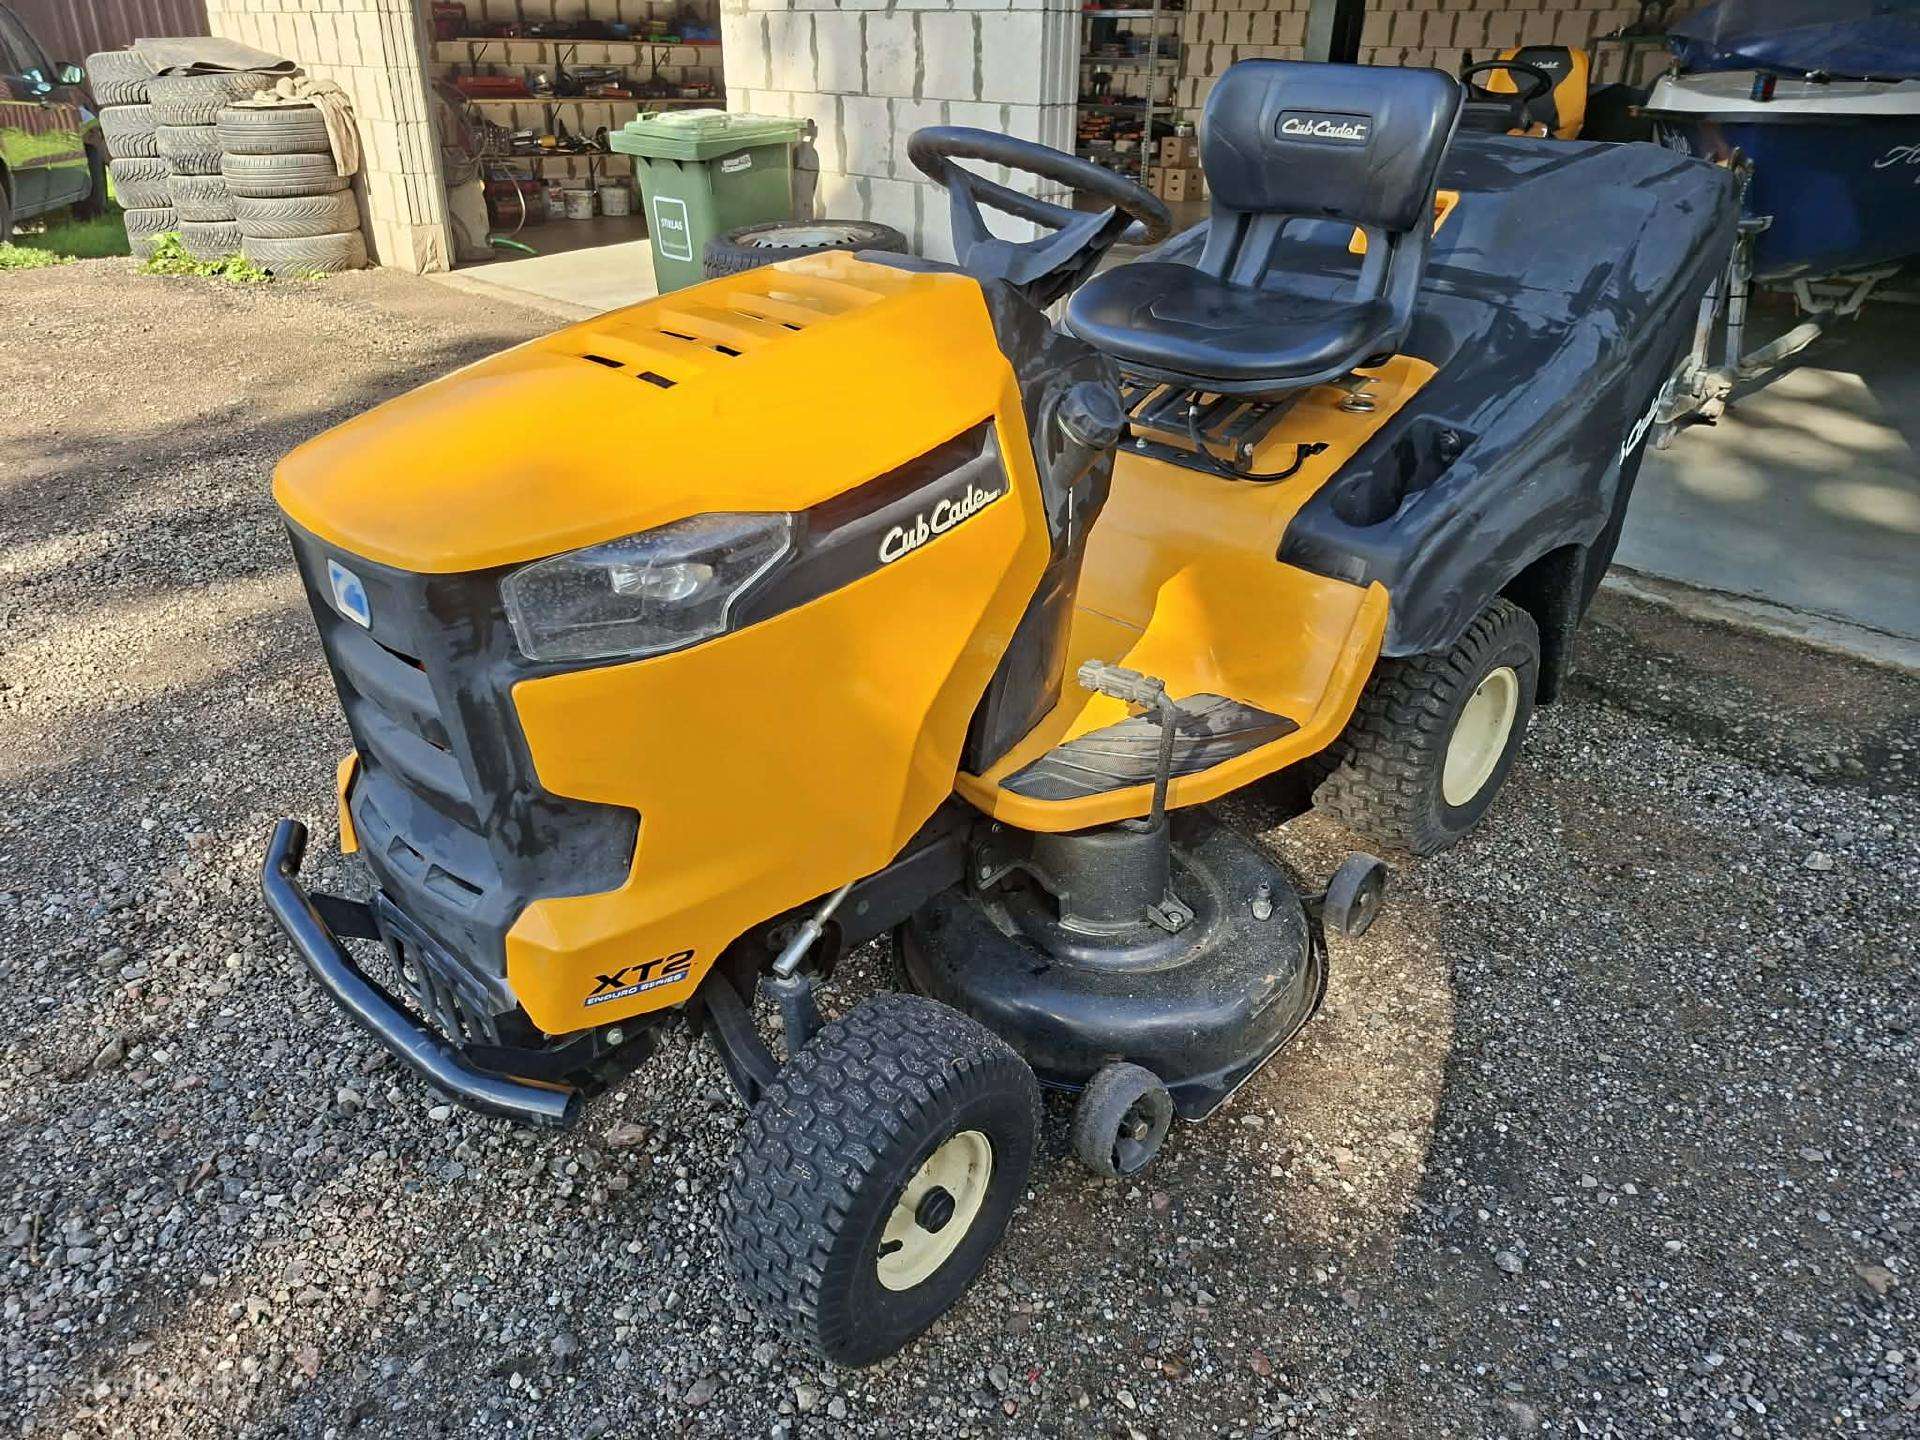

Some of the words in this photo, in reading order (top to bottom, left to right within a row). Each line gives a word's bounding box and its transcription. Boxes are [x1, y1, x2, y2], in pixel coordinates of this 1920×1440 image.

[1281, 118, 1314, 136] Cub
[1313, 120, 1368, 140] Cadet
[879, 513, 930, 563] Cub
[585, 985, 638, 1006] ENDURO
[640, 972, 683, 992] SERIES
[588, 949, 695, 997] XT2
